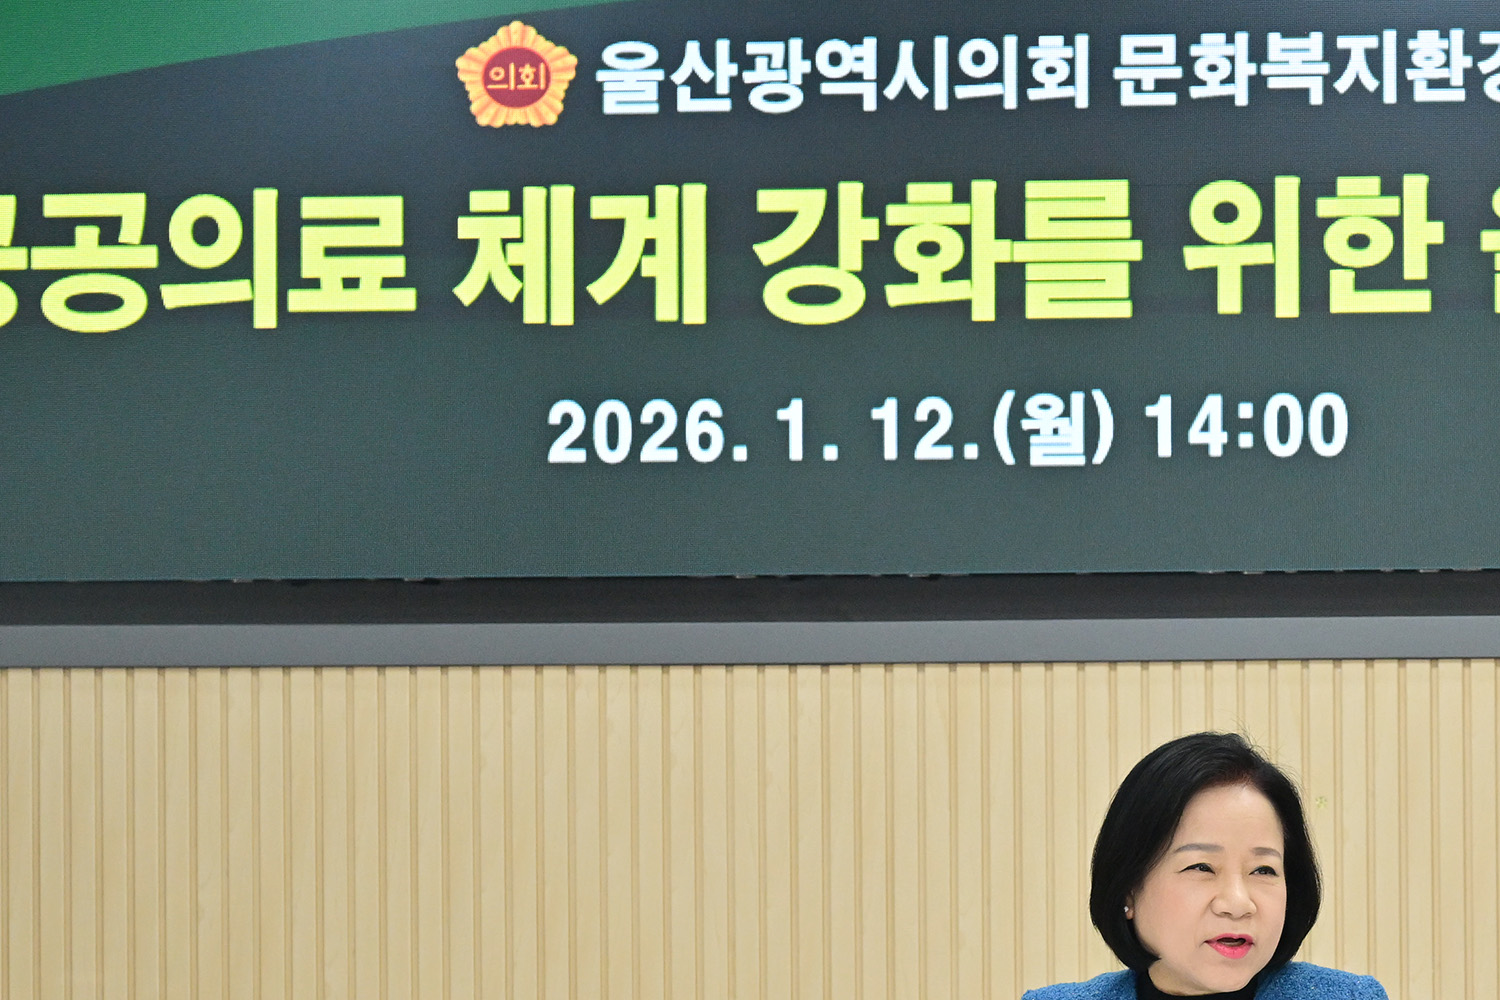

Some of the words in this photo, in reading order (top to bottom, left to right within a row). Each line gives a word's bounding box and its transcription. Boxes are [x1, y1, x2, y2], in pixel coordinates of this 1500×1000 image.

[486, 61, 547, 91] 의회
[596, 35, 1090, 115] 울산광역시의회
[0, 188, 417, 334] 공의료
[453, 184, 708, 327] 체계
[752, 180, 1143, 326] 강화를
[1183, 173, 1445, 319] 위한
[547, 398, 749, 465] 2026.
[776, 398, 839, 462] 1.
[870, 390, 1115, 467] 12.(월)
[1144, 392, 1349, 459] 14:00
